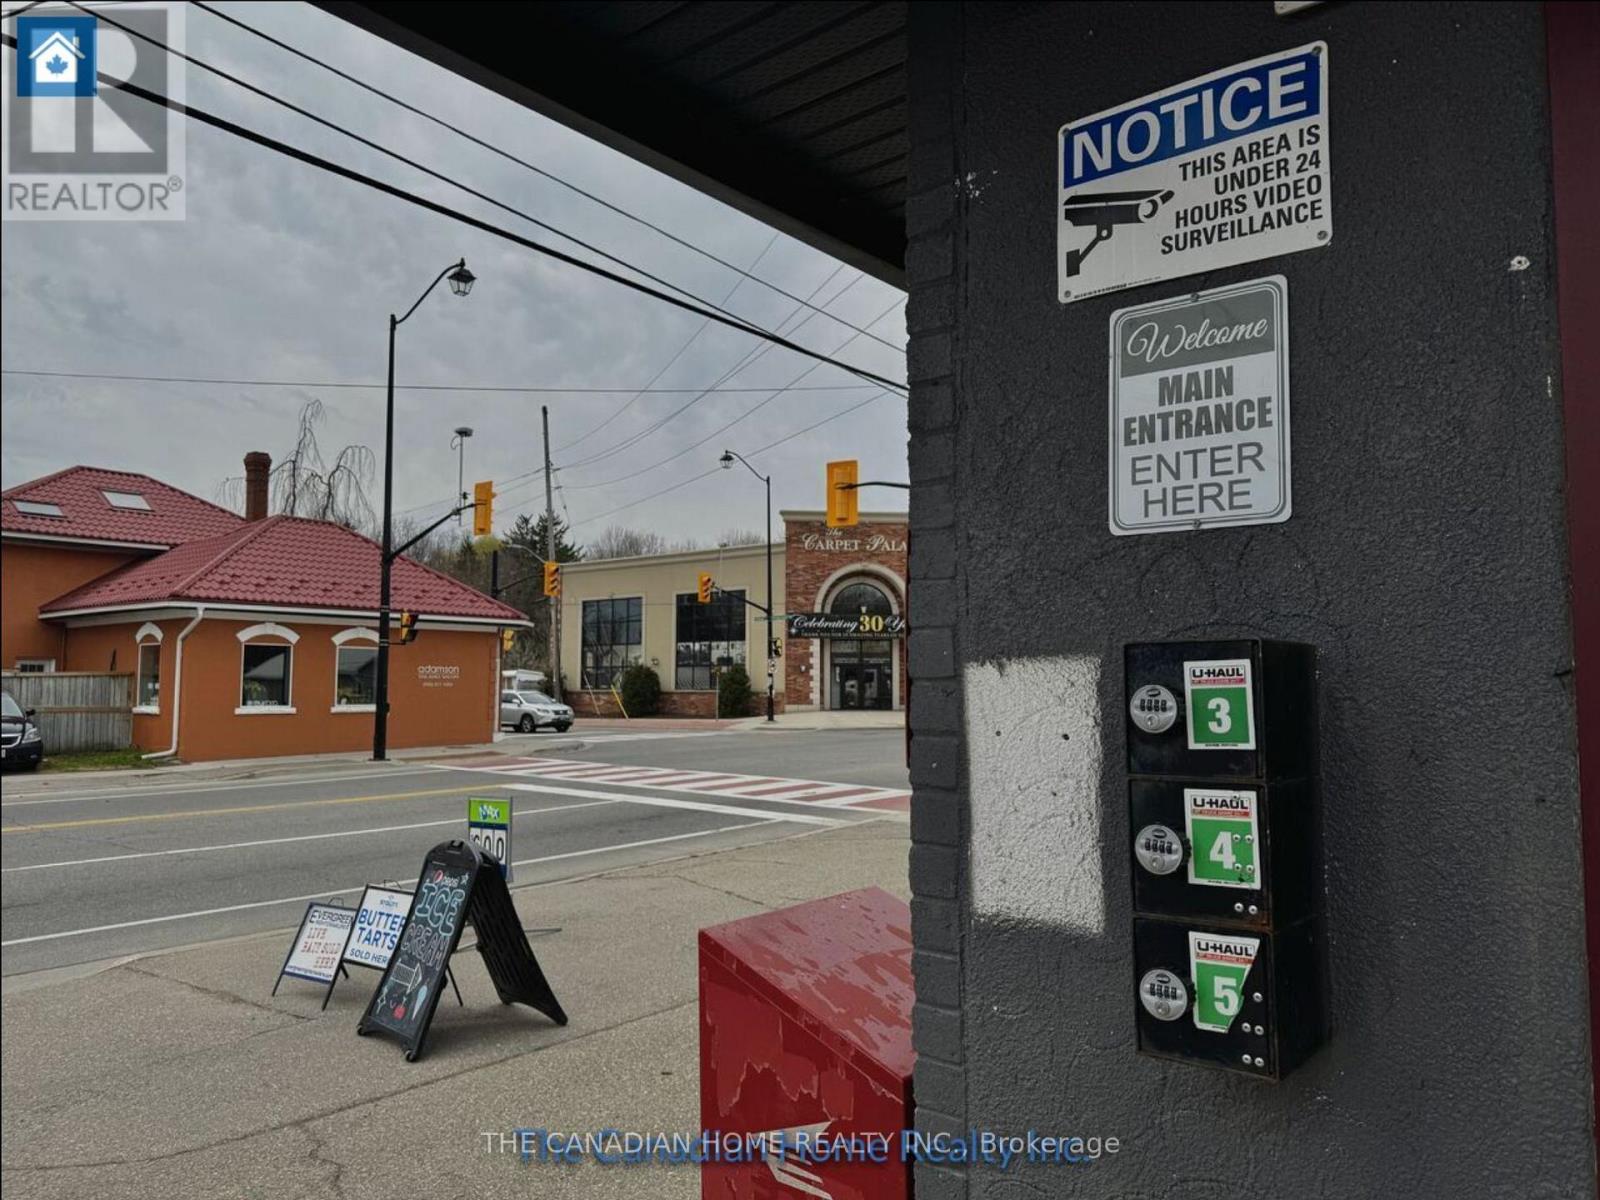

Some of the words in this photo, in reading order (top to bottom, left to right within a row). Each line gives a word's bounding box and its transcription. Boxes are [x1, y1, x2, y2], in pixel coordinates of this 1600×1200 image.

[1072, 62, 1307, 179] NOTICE
[1179, 152, 1226, 181] THIS
[1233, 133, 1291, 167] AREA
[1299, 124, 1321, 148] IS
[1214, 158, 1289, 195] UNDER
[1296, 150, 1321, 174] 24
[1175, 194, 1247, 229] HOURS
[1254, 174, 1322, 208] VIDEO
[1160, 200, 1323, 255] SURVEILLANCE
[1127, 319, 1268, 362] Welcome
[1158, 365, 1234, 407] MAIN
[1123, 396, 1273, 447] ENTRANCE
[1131, 441, 1266, 486] ENTER
[1143, 478, 1252, 518] HERE
[802, 533, 861, 551] CARPET
[826, 528, 844, 536] The
[793, 614, 858, 632] Celebrating
[860, 615, 884, 632] 30
[1192, 667, 1243, 678] U-HAUL
[1207, 697, 1232, 734] 3
[1193, 797, 1249, 809] U-HAUL
[1209, 831, 1236, 870] 4
[415, 882, 466, 936] ICE
[349, 947, 371, 960] SOLD
[357, 927, 398, 951] TARTS
[1197, 941, 1253, 957] U-HAUL
[1213, 976, 1240, 1016] 5
